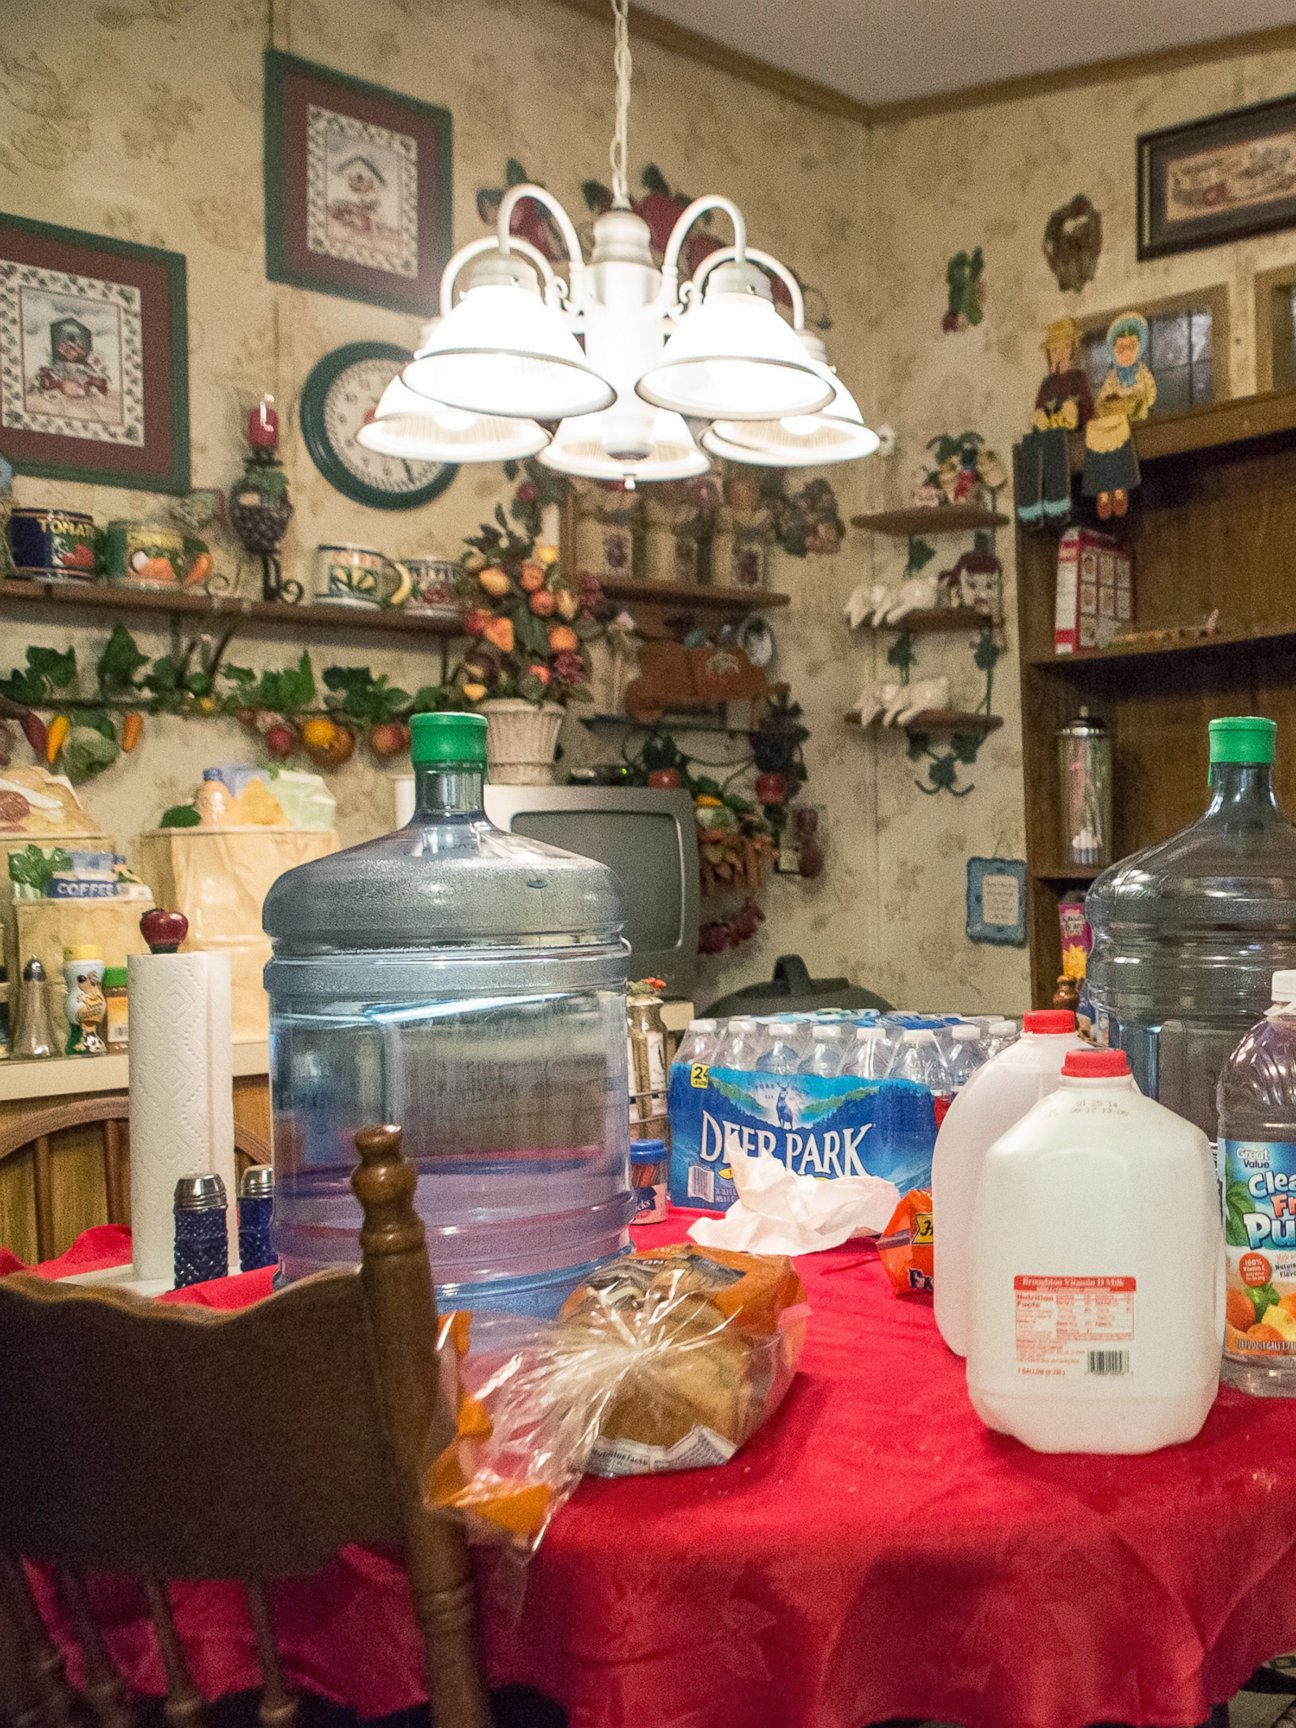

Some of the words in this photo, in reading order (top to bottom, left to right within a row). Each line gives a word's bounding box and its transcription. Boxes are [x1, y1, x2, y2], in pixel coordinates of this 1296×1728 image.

[57, 883, 116, 897] COFFEE
[785, 1123, 873, 1178] PARK
[1236, 1147, 1270, 1161] Great
[1243, 1159, 1270, 1169] Value
[1245, 1258, 1263, 1266] 100%
[1064, 1277, 1096, 1287] Vitamin
[1097, 1278, 1105, 1286] D
[1106, 1278, 1125, 1287] Milk
[1017, 1294, 1054, 1302] Nutrition
